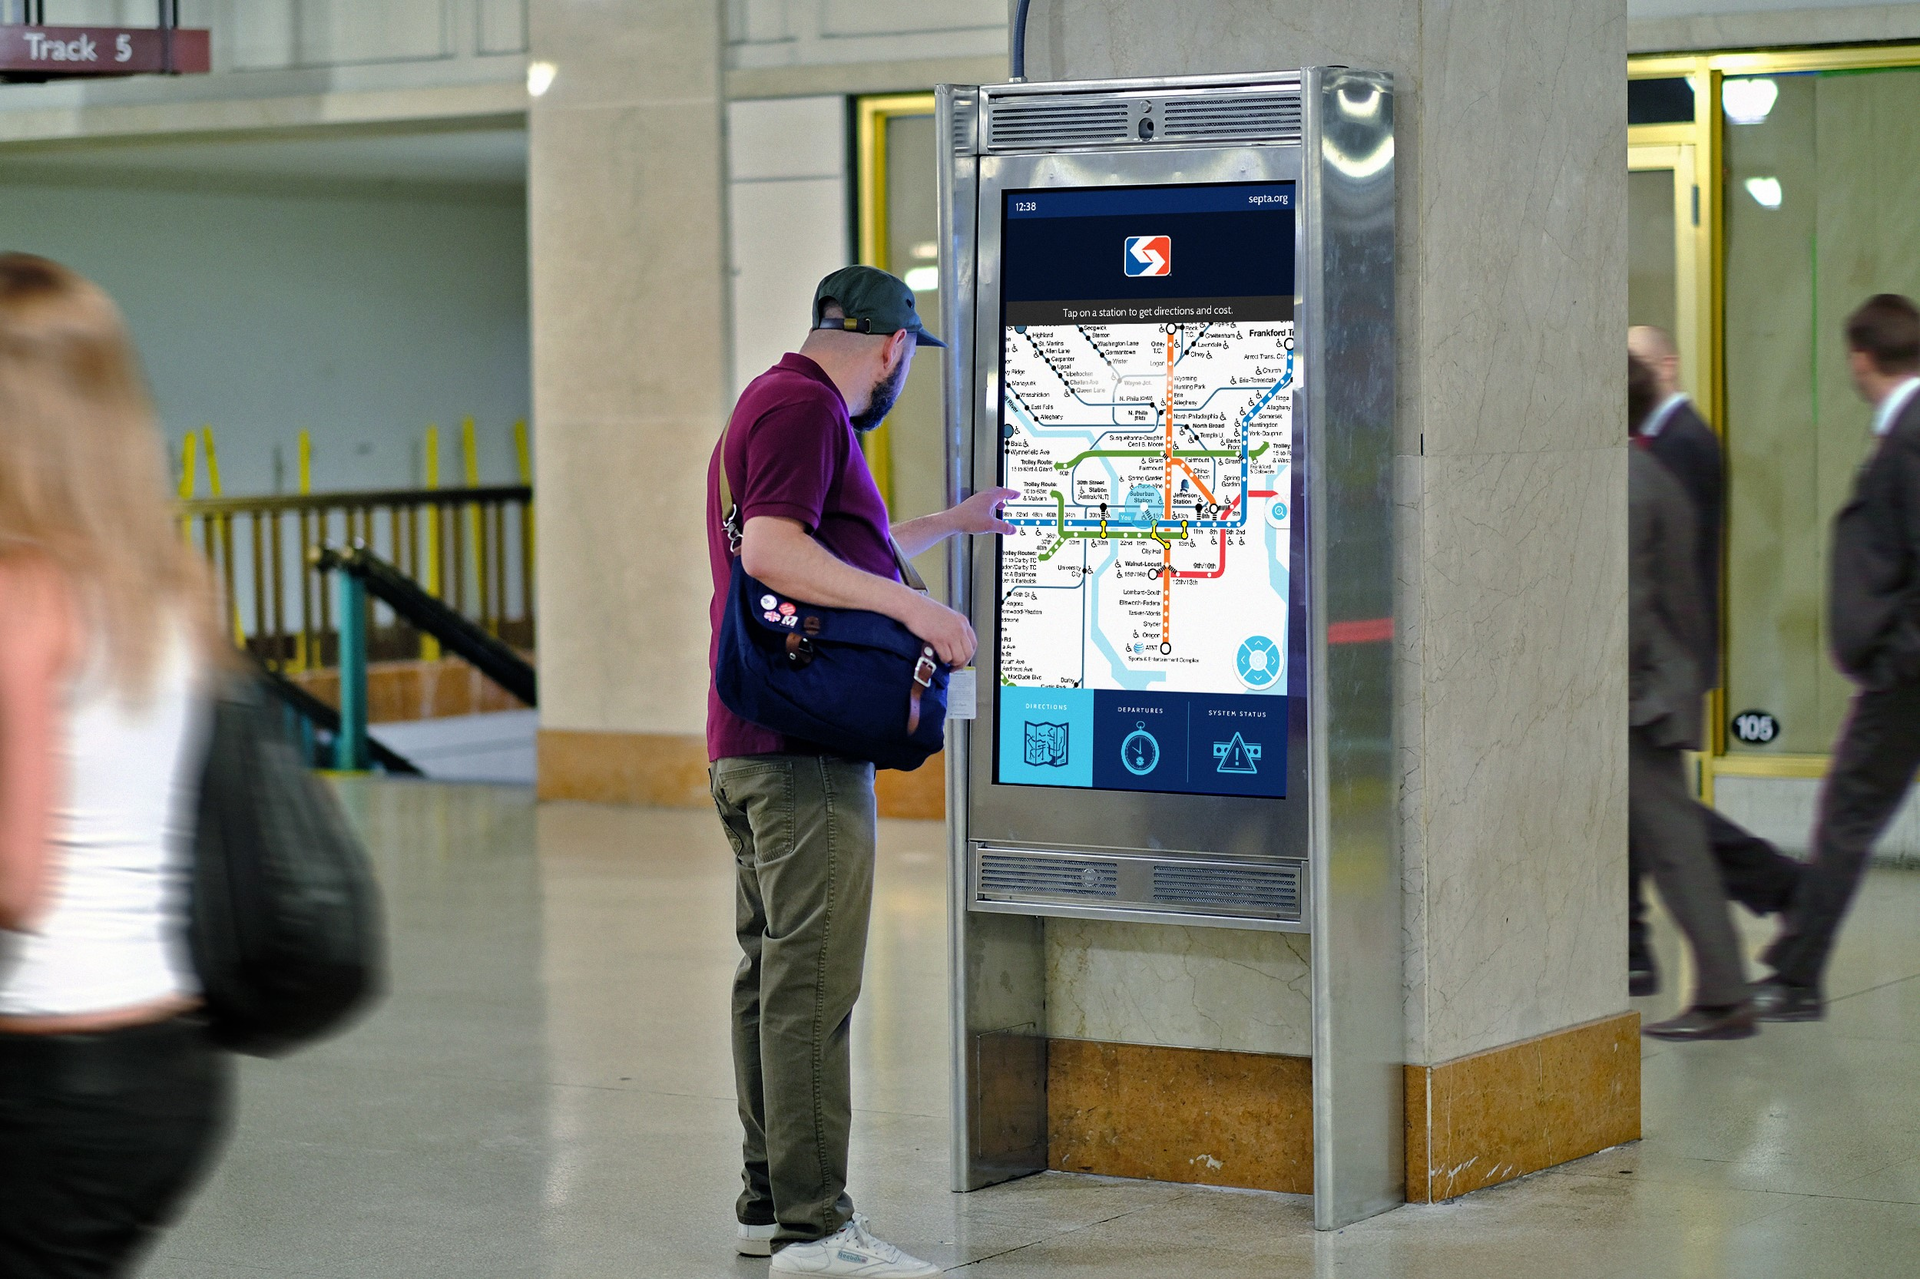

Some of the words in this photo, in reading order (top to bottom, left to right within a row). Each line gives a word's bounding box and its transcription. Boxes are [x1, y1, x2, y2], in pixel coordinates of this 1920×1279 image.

[23, 32, 99, 62] Track
[114, 33, 133, 62] 5
[1248, 194, 1288, 206] septa.org
[1015, 202, 1037, 212] 12:38
[1063, 308, 1078, 320] Tap
[1080, 310, 1090, 318] on
[1099, 308, 1127, 317] station
[1129, 308, 1137, 316] to
[1139, 308, 1152, 319] get
[1154, 306, 1194, 316] directions
[1196, 306, 1212, 315] and
[1214, 307, 1233, 315] cost.
[1249, 329, 1286, 337] Frankford
[1007, 400, 1018, 412] River
[1026, 703, 1067, 711] DIRECTIONS
[1118, 706, 1163, 714] DEPARTURES
[1736, 714, 1773, 741] 105
